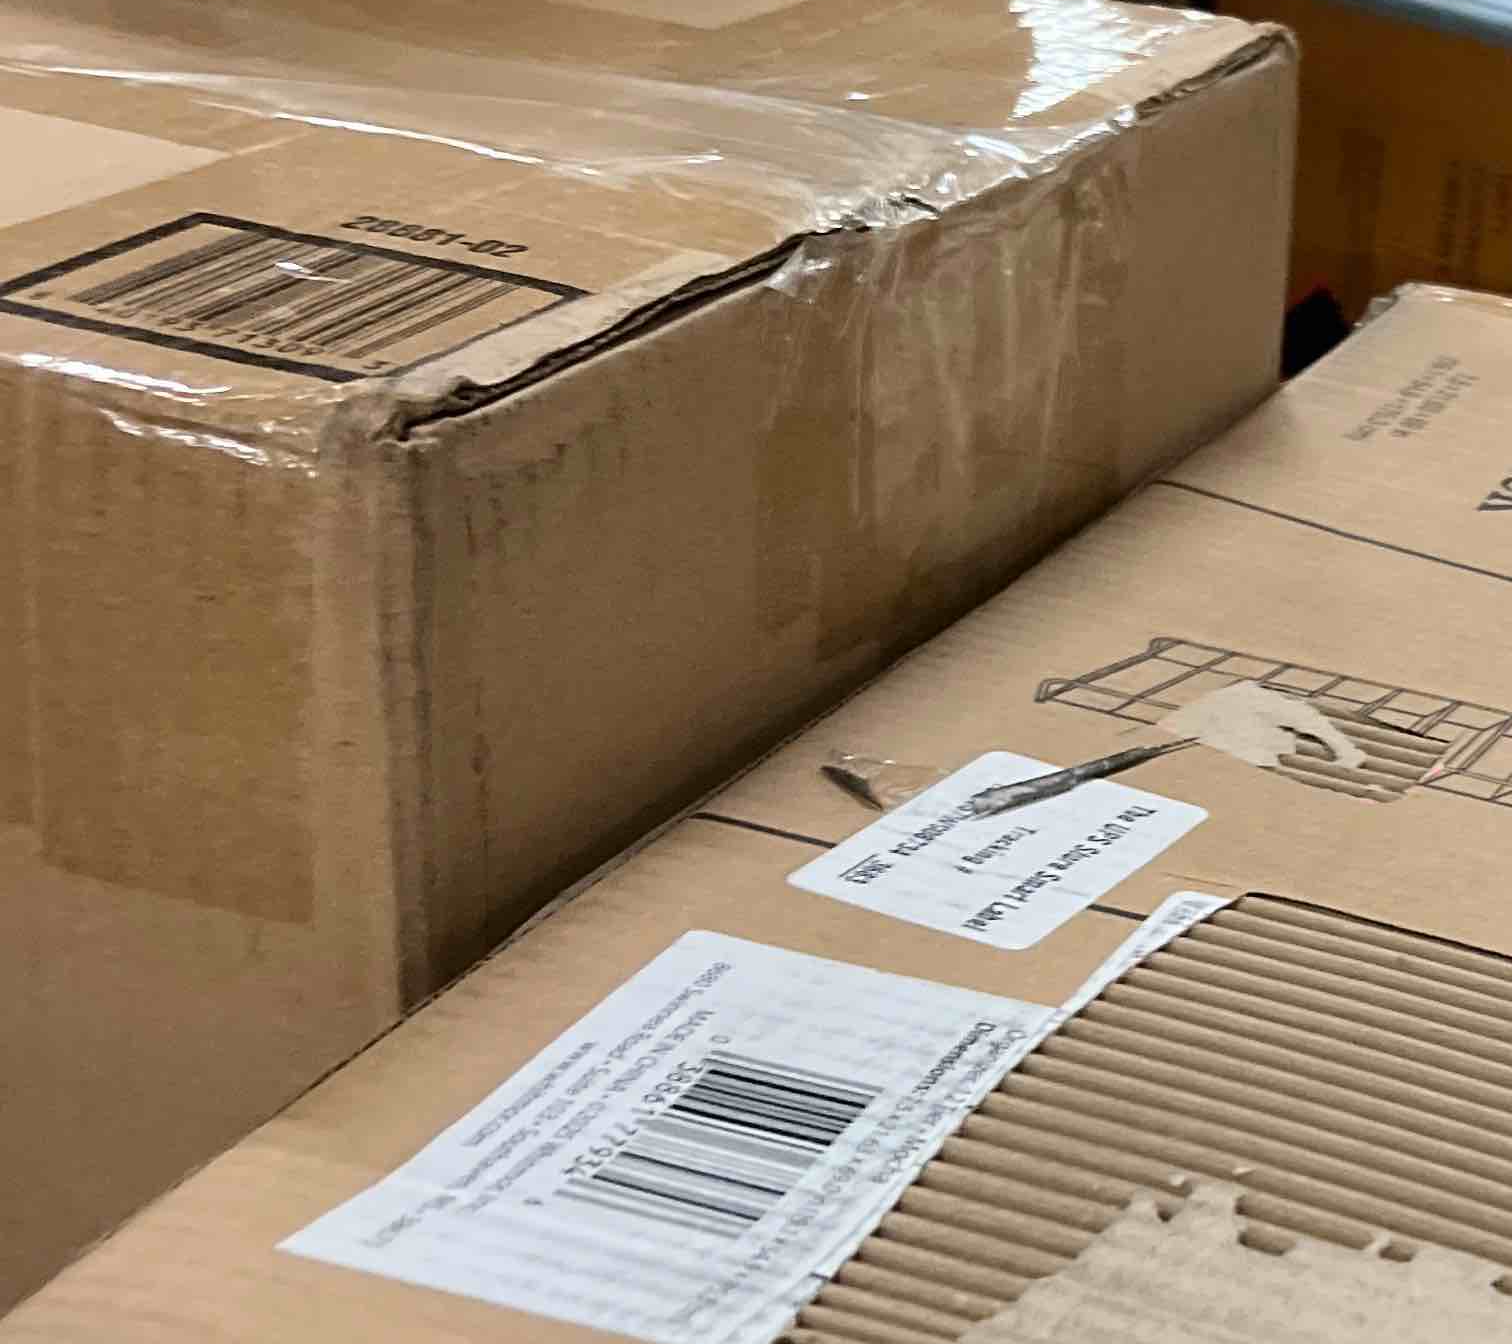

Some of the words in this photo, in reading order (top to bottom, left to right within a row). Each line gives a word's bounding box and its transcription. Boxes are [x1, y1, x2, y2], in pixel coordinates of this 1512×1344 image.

[1114, 804, 1157, 824] The
[958, 822, 1038, 867] Tracking
[1083, 821, 1131, 846] UPS
[1046, 843, 1100, 872] Store
[1001, 869, 1062, 903] Smart
[959, 900, 1020, 933] Label
[908, 1020, 999, 1097] Dimensions:
[622, 1060, 709, 1118] 38861
[554, 1121, 641, 1180] 77934
